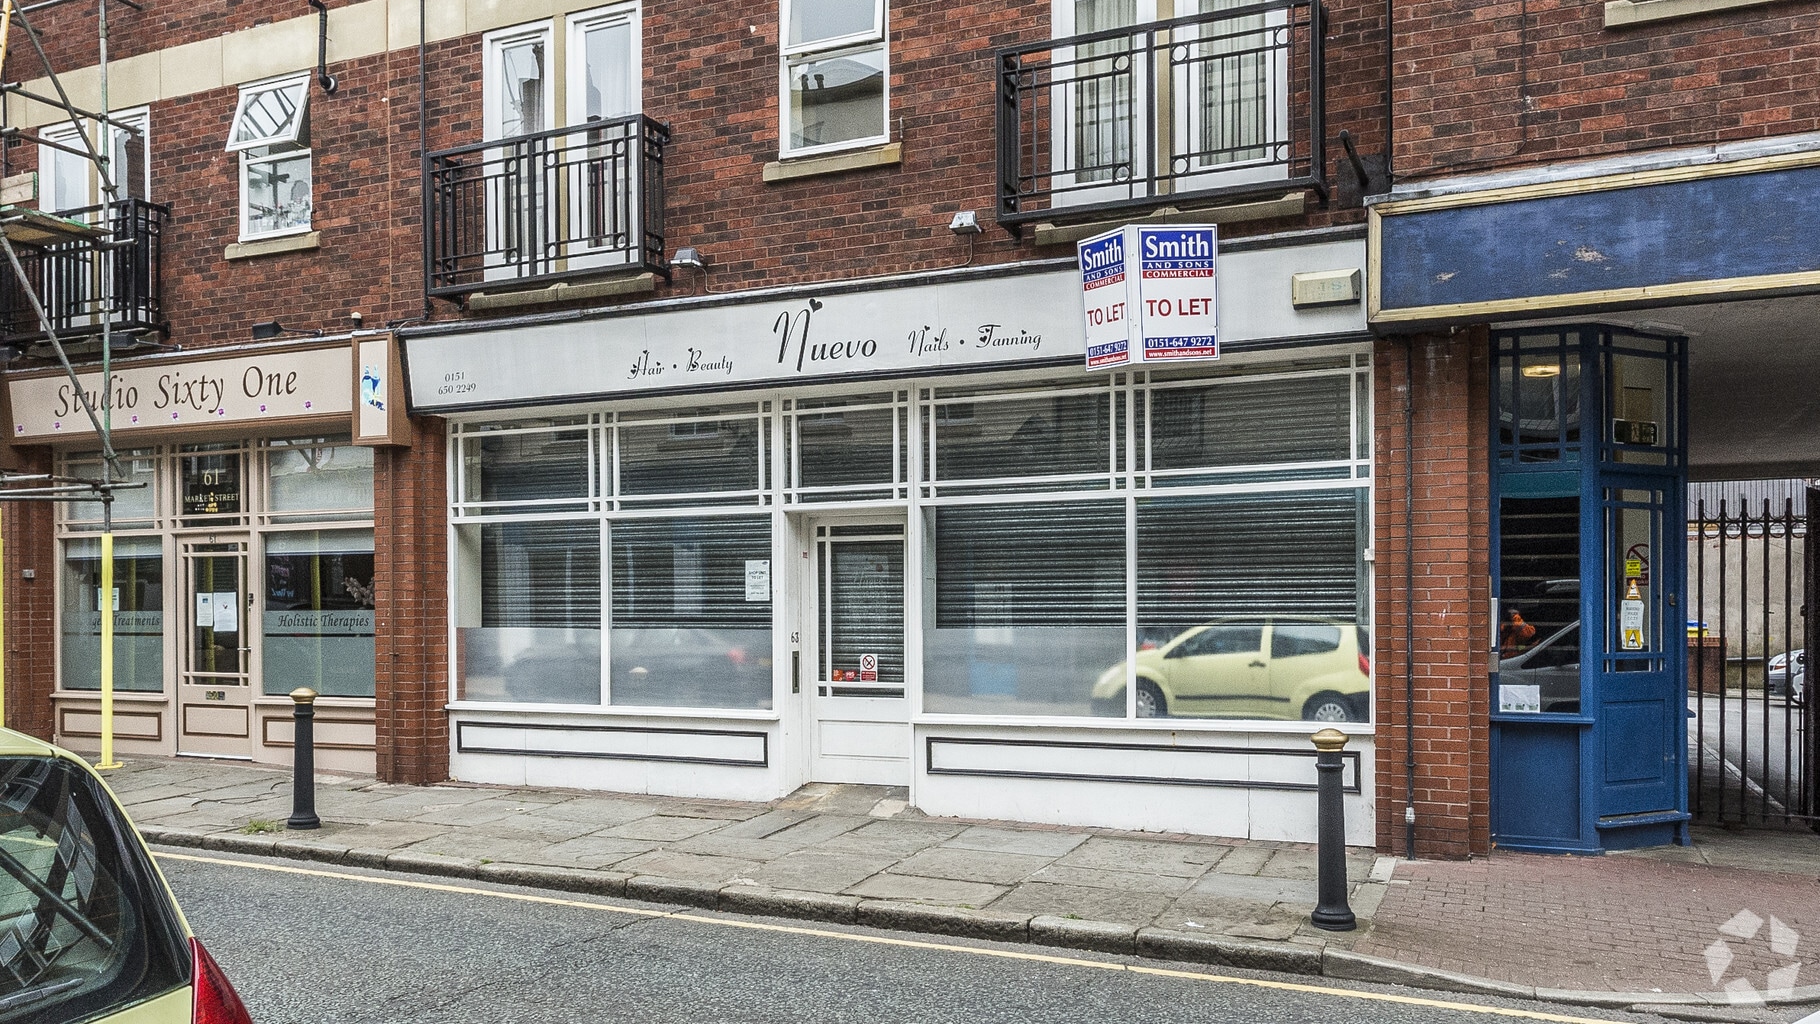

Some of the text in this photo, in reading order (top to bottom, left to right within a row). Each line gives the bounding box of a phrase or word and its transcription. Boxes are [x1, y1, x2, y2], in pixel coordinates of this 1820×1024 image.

[1145, 233, 1209, 258] Smith
[1083, 238, 1122, 271] Smith
[1086, 265, 1123, 281] AND SONS
[1146, 270, 1210, 278] COMMERCIAL
[1085, 275, 1124, 291] COMMERCIAL
[1087, 302, 1125, 326] TO LET
[1146, 298, 1212, 316] TO LET
[773, 307, 877, 372] Nuevo
[908, 324, 1041, 356] Nails Tanning
[1148, 336, 1212, 347] 0151-647 9272
[1090, 340, 1127, 356] 0151-647 9272
[1149, 349, 1212, 357] www.smithandsons.net
[627, 349, 733, 379] Hair Beauty
[444, 372, 464, 382] 0151
[154, 372, 224, 413] Sixty
[242, 365, 297, 397] One
[438, 383, 477, 395] 650 2249
[203, 468, 219, 485] 61
[184, 493, 239, 503] MARKET STREET
[113, 614, 160, 626] Treatments
[278, 613, 370, 631] Holistic Therapies
[791, 631, 800, 644] 63
